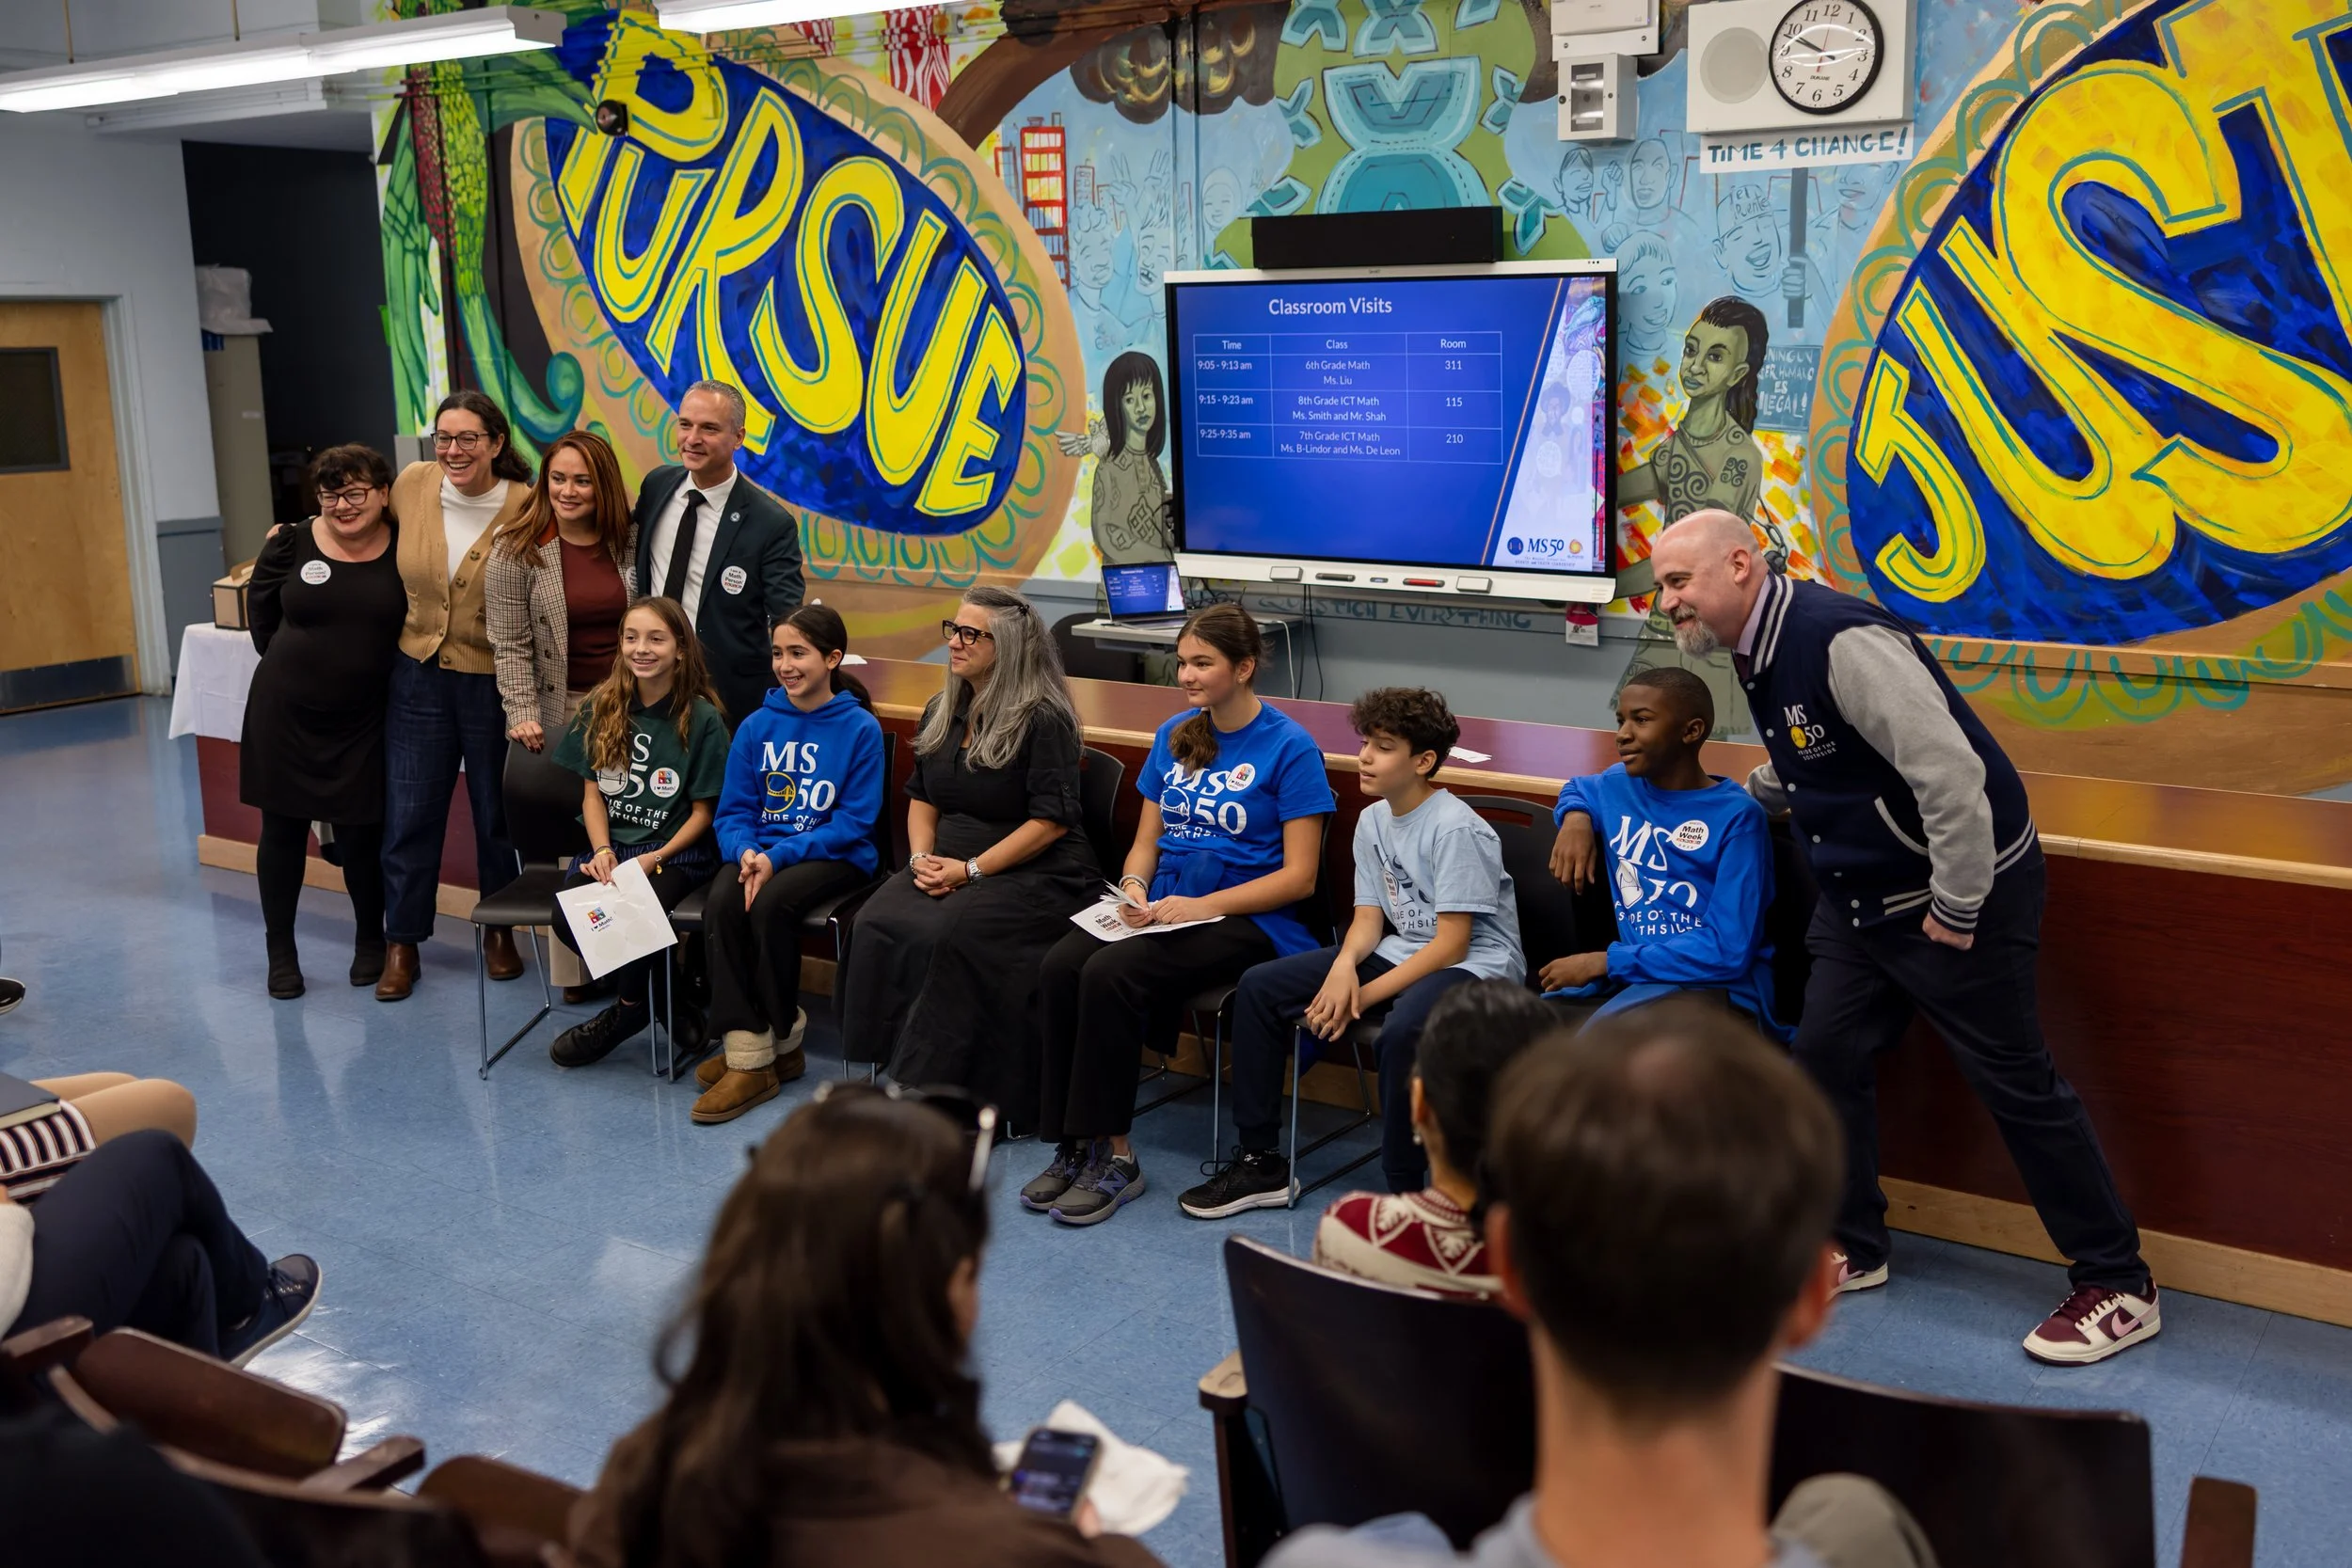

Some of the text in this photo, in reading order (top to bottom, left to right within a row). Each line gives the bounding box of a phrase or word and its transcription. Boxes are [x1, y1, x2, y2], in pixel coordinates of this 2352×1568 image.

[1804, 9, 1819, 22] 11
[1822, 4, 1841, 17] 12
[1847, 11, 1854, 24] 1
[1788, 23, 1803, 36] 10
[1854, 28, 1867, 42] 2
[1780, 43, 1790, 56] 9
[1857, 49, 1867, 62] 3
[1781, 65, 1793, 79] 8
[1848, 68, 1859, 82] 4
[1795, 82, 1805, 95] 7
[1833, 84, 1844, 98] 5
[1812, 88, 1822, 103] 6
[1708, 126, 1908, 164] TIME 4 CHANGE!
[559, 10, 1023, 517] PURSUE
[1268, 296, 1392, 315] Classroom Visits
[1221, 340, 1242, 350] Time
[1326, 339, 1348, 349] Class
[1440, 339, 1467, 349] Room
[1197, 360, 1216, 371] 9:05
[1221, 360, 1239, 371] 9:13
[1240, 362, 1252, 371] am
[1305, 360, 1371, 370] 6th Grade Math
[1444, 359, 1462, 371] 311
[1323, 374, 1353, 385] Ms. Liu
[1773, 380, 1788, 394] ES
[1199, 395, 1216, 405] 9:15
[1222, 395, 1240, 405] 9:23
[1241, 397, 1253, 405] am
[1297, 395, 1380, 406] 8th Grade ICT Math
[1445, 397, 1463, 407] 115
[1292, 410, 1387, 421] Ms. Smith and Mr. Shah
[1200, 429, 1251, 439] 9:25-9:35 am
[1299, 431, 1380, 442] 7th Grade ICT Math
[1445, 434, 1464, 444] 210
[1280, 444, 1401, 456] Ms. B-Lindor and Ms. De Leon
[1784, 705, 1808, 726] MS
[1804, 724, 1825, 747] 50
[759, 741, 819, 774] MS
[1803, 748, 1836, 760] SOUTHSIDE
[623, 762, 649, 799] 5
[1163, 762, 1231, 797] MS
[797, 778, 836, 812] 50
[625, 803, 643, 815] OF
[646, 808, 669, 820] THE
[761, 810, 790, 822] RIDE
[1194, 797, 1248, 835] 50
[1681, 825, 1705, 834] Math
[1678, 832, 1703, 841] Week
[1610, 816, 1673, 872] MS
[1095, 914, 1112, 925] Math
[1670, 911, 1703, 927] THE
